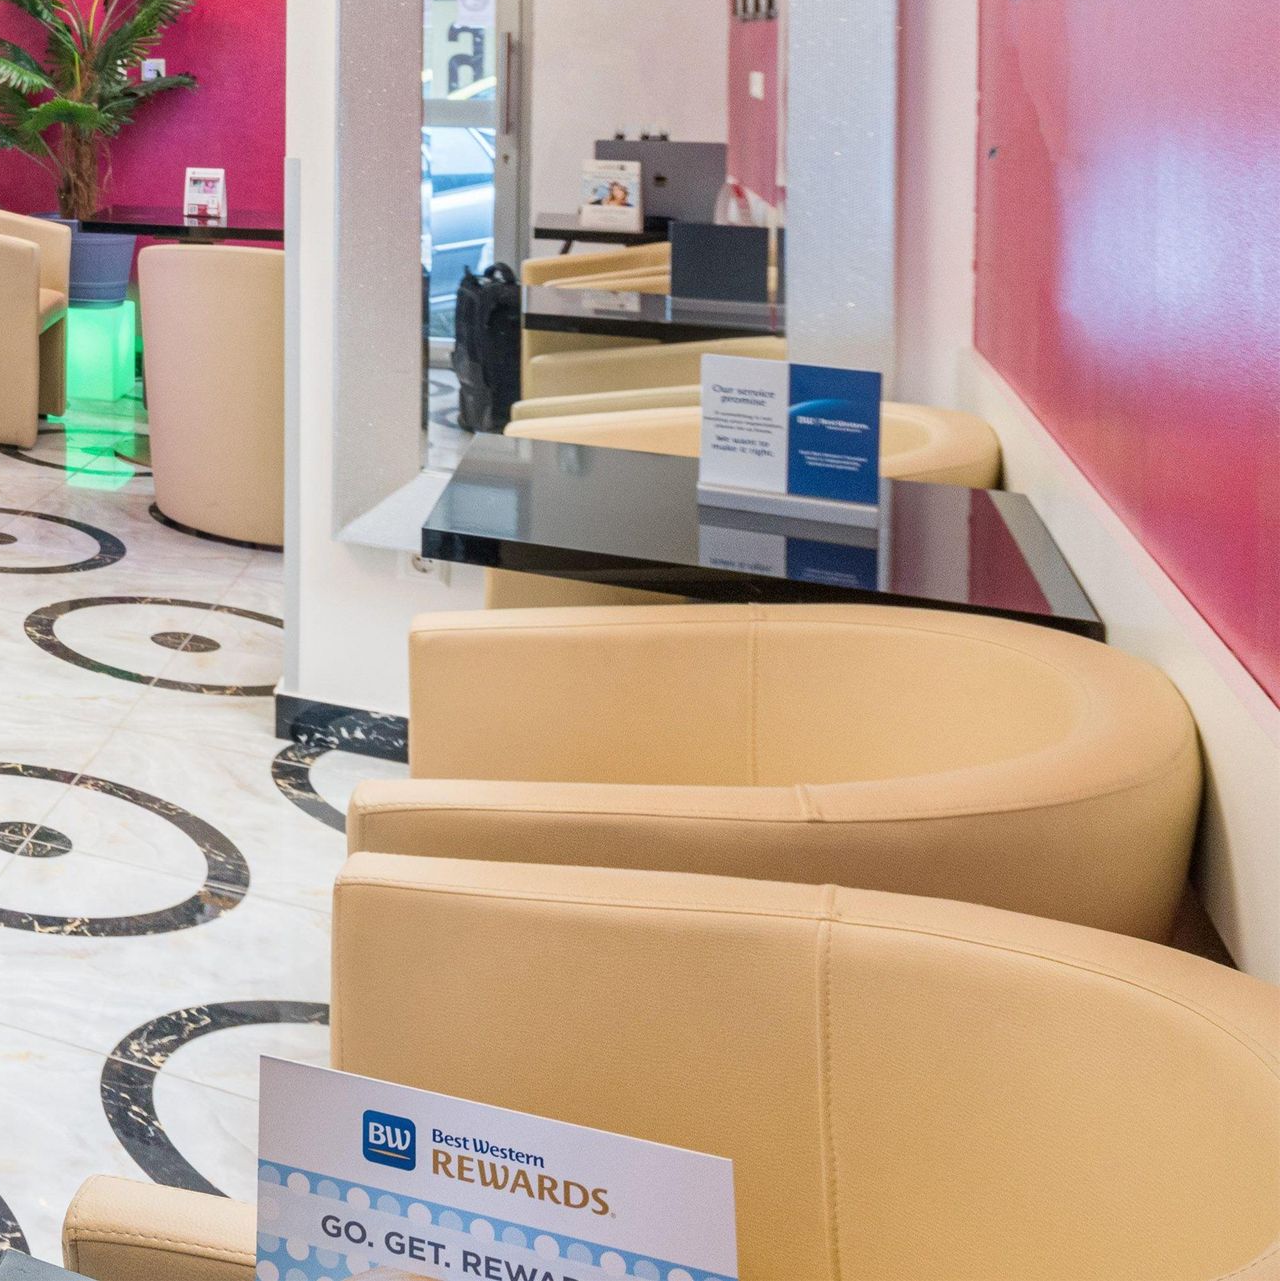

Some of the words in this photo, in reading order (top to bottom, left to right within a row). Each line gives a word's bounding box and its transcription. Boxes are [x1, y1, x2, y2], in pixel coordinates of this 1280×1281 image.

[368, 1121, 412, 1151] BW
[432, 1128, 469, 1150] Best
[473, 1134, 545, 1168] Western
[431, 1149, 611, 1217] REWARDS
[321, 1214, 374, 1247] GO.
[384, 1230, 451, 1268] GET.
